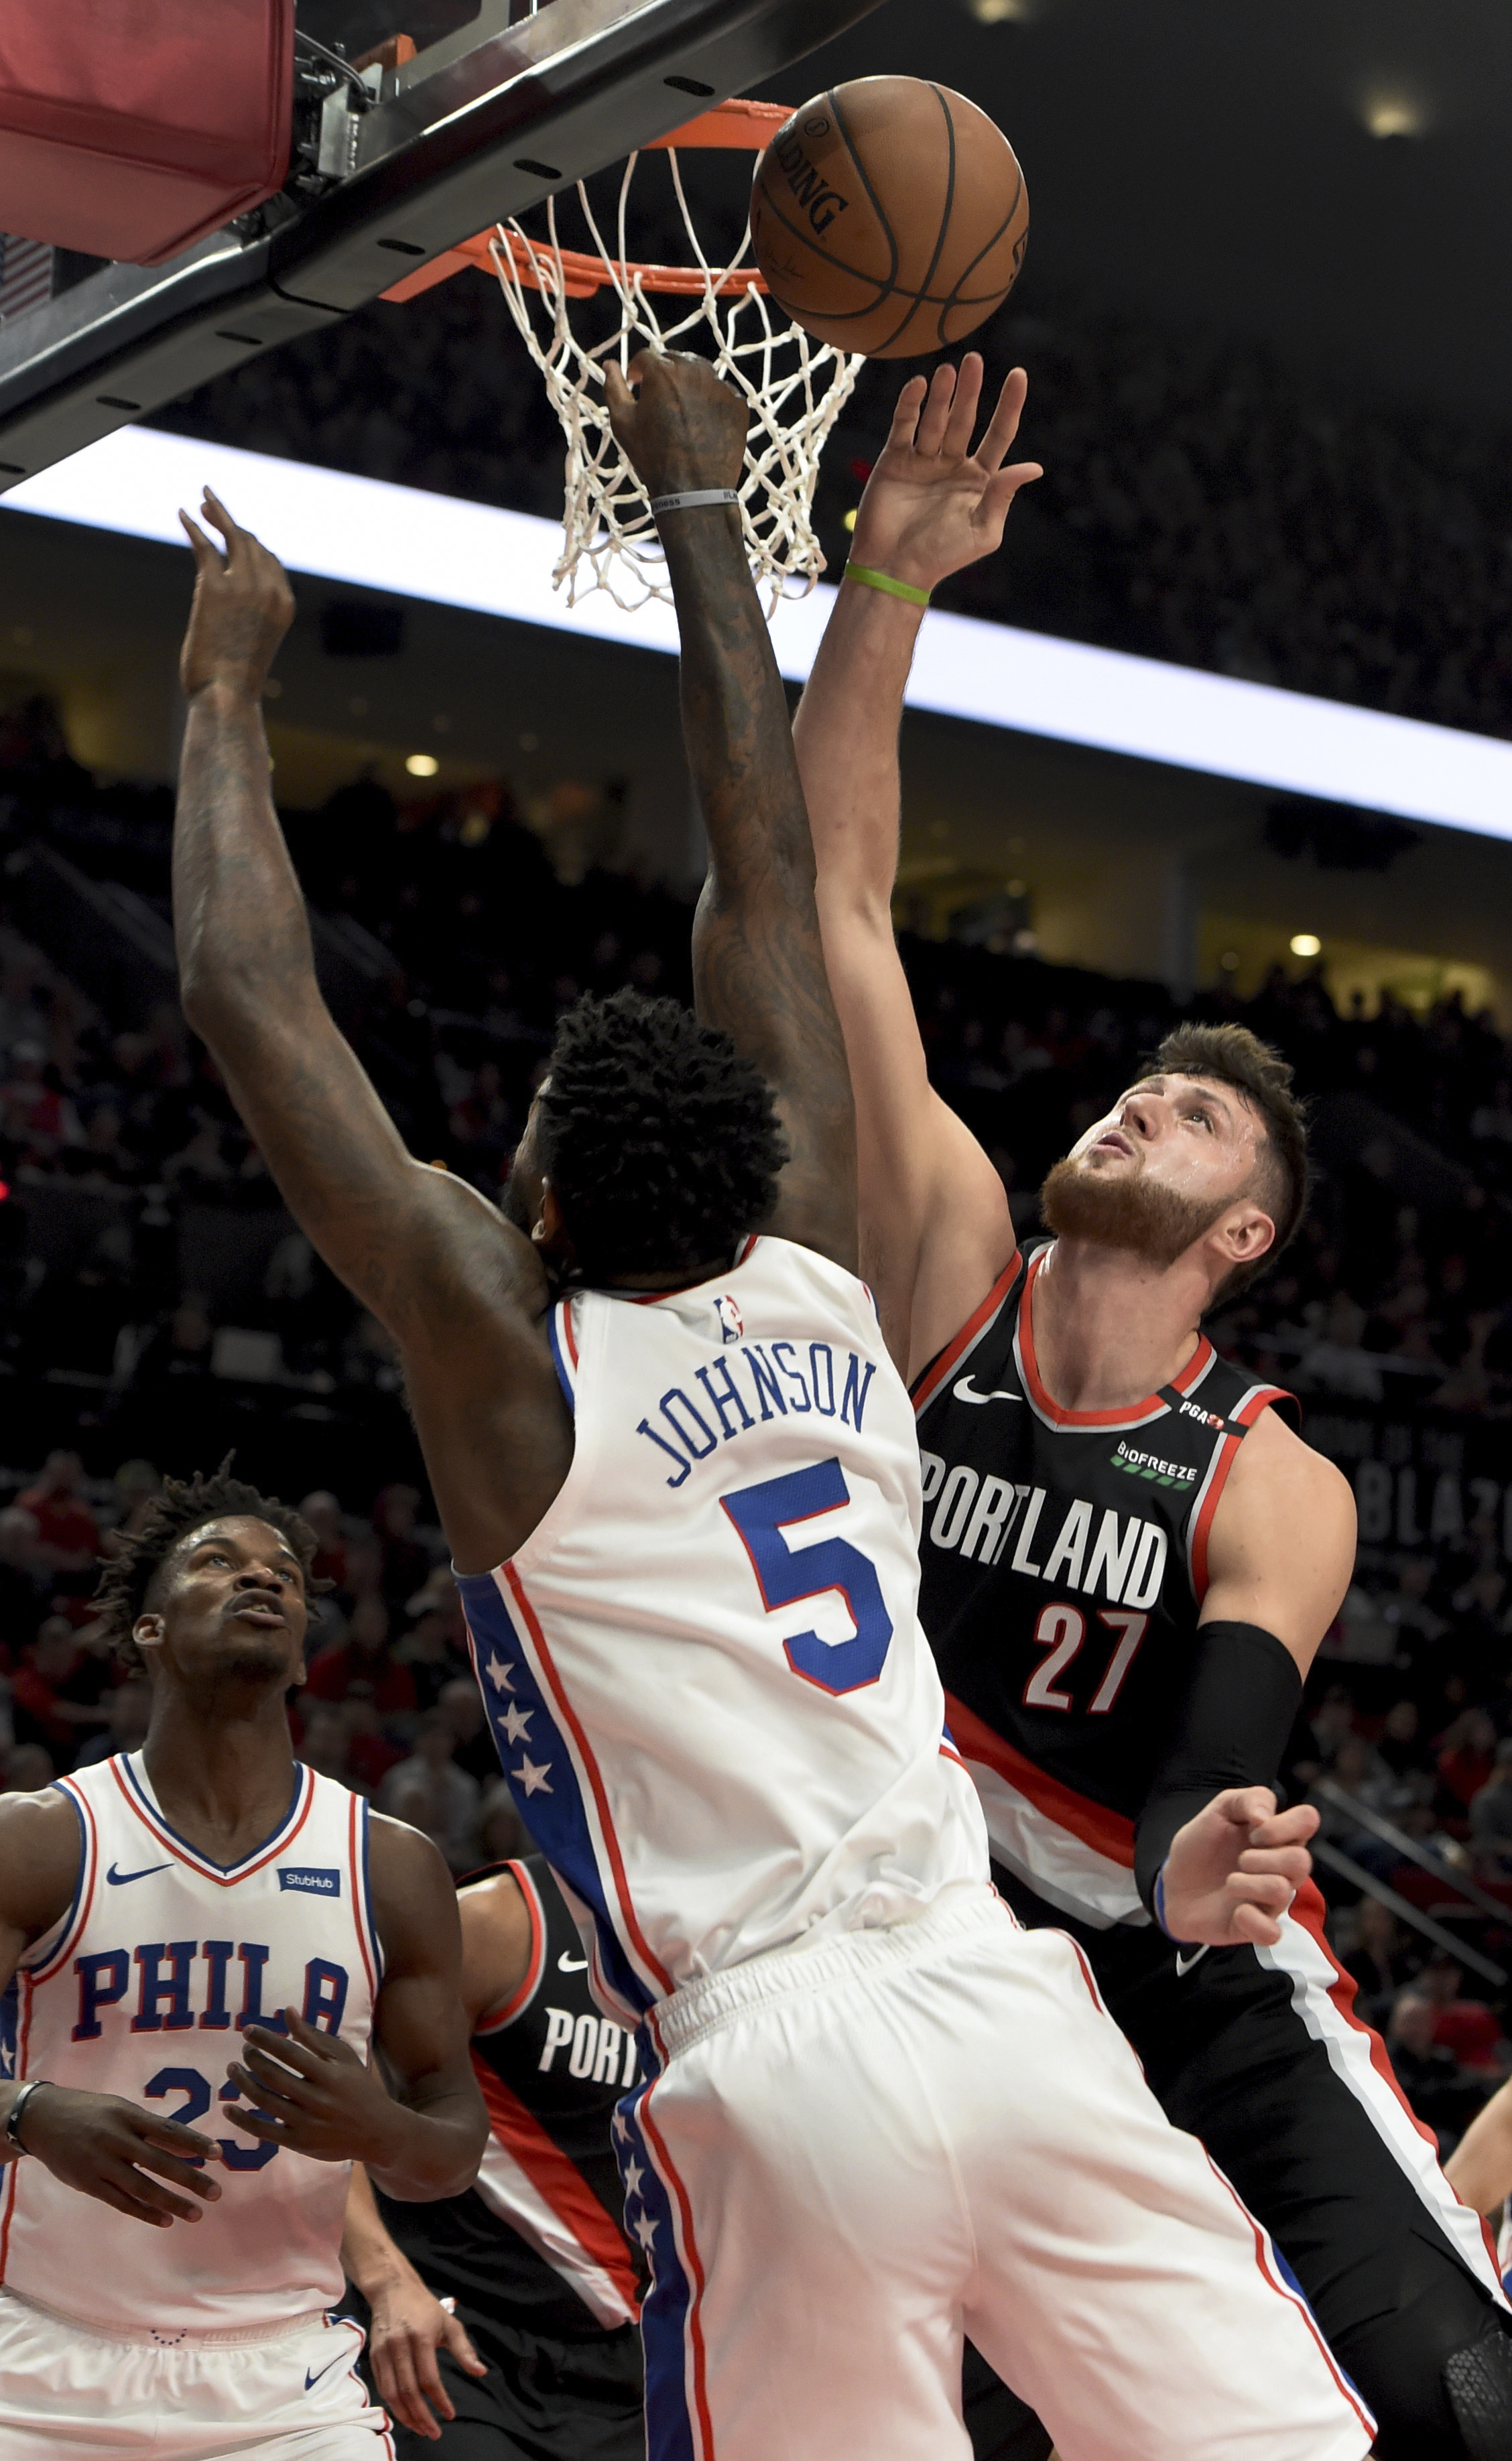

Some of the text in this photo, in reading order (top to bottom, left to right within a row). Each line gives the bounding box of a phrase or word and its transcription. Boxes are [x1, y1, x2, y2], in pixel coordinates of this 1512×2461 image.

[636, 1342, 877, 1488] JOHNSON
[1179, 1401, 1208, 1425] PGA
[720, 1456, 894, 1696] 5
[920, 1449, 1168, 1610] PORTLAND
[1022, 1602, 1149, 1715] 27
[286, 1874, 333, 1889] StubHub
[72, 1940, 349, 2042] PHILA
[538, 2007, 647, 2088] PORT
